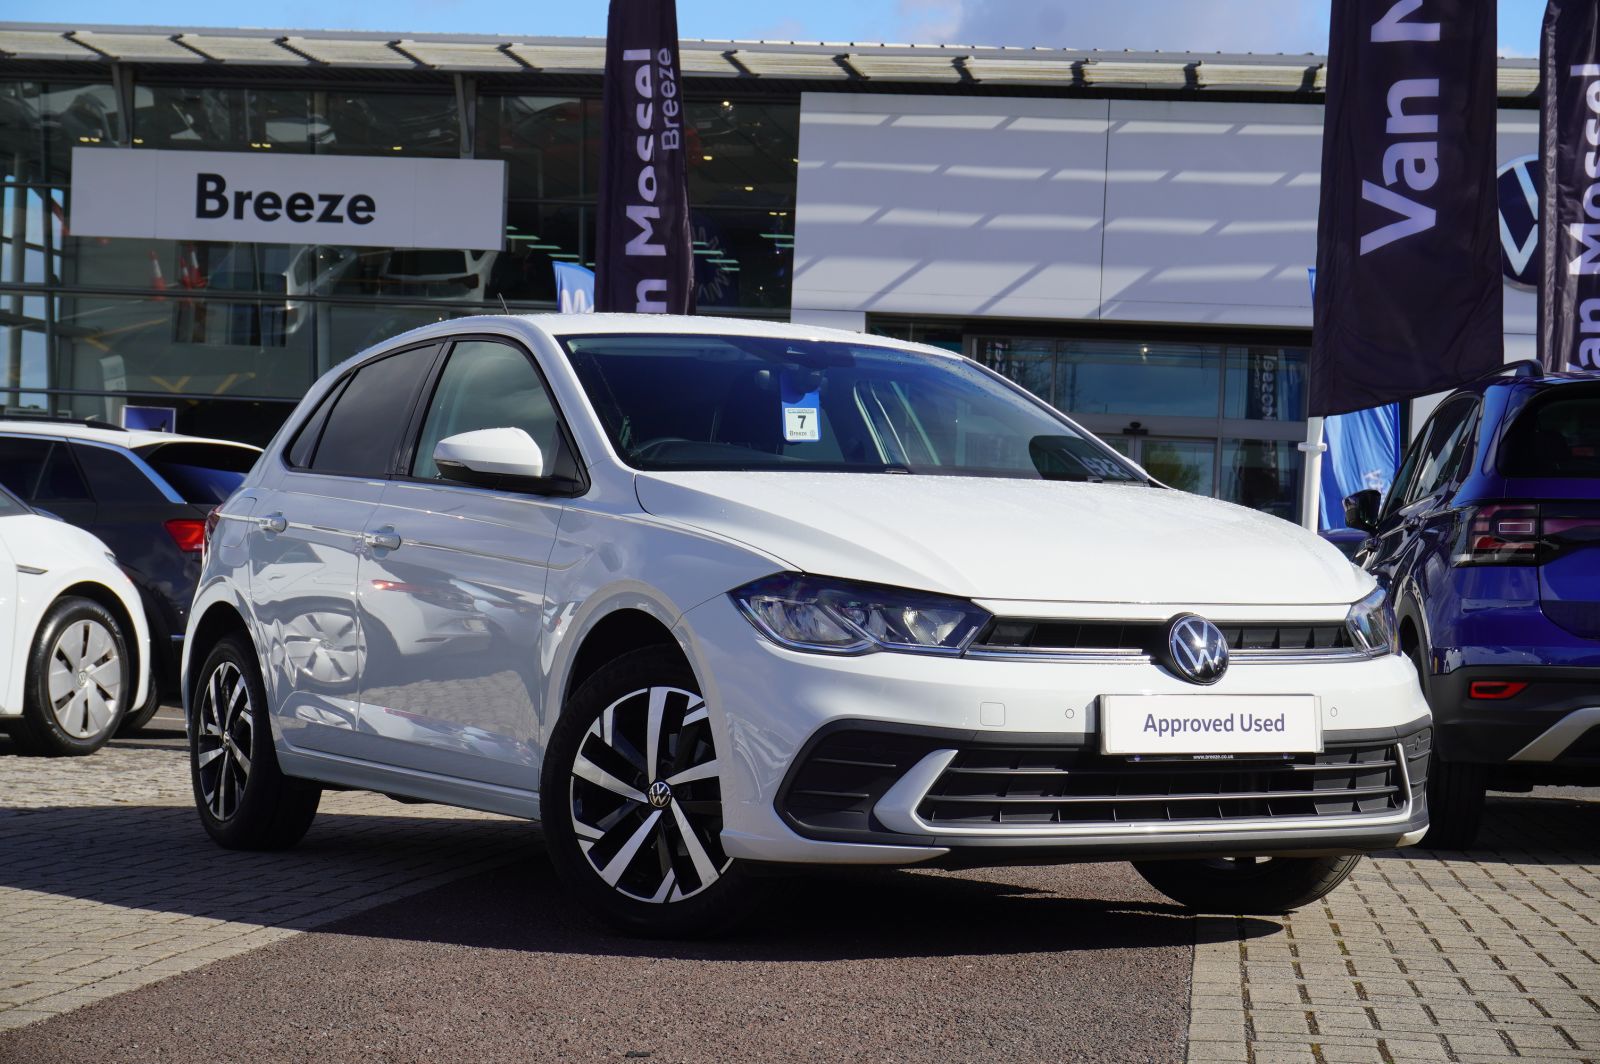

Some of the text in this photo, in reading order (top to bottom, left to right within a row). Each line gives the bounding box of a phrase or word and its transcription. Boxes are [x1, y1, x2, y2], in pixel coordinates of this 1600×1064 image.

[657, 47, 680, 150] Breeze
[623, 48, 667, 257] Mossel
[1359, 77, 1441, 256] Van
[195, 172, 376, 225] Breeze
[1566, 297, 1600, 372] an
[797, 415, 807, 429] 7
[1143, 712, 1285, 737] Approved Used
